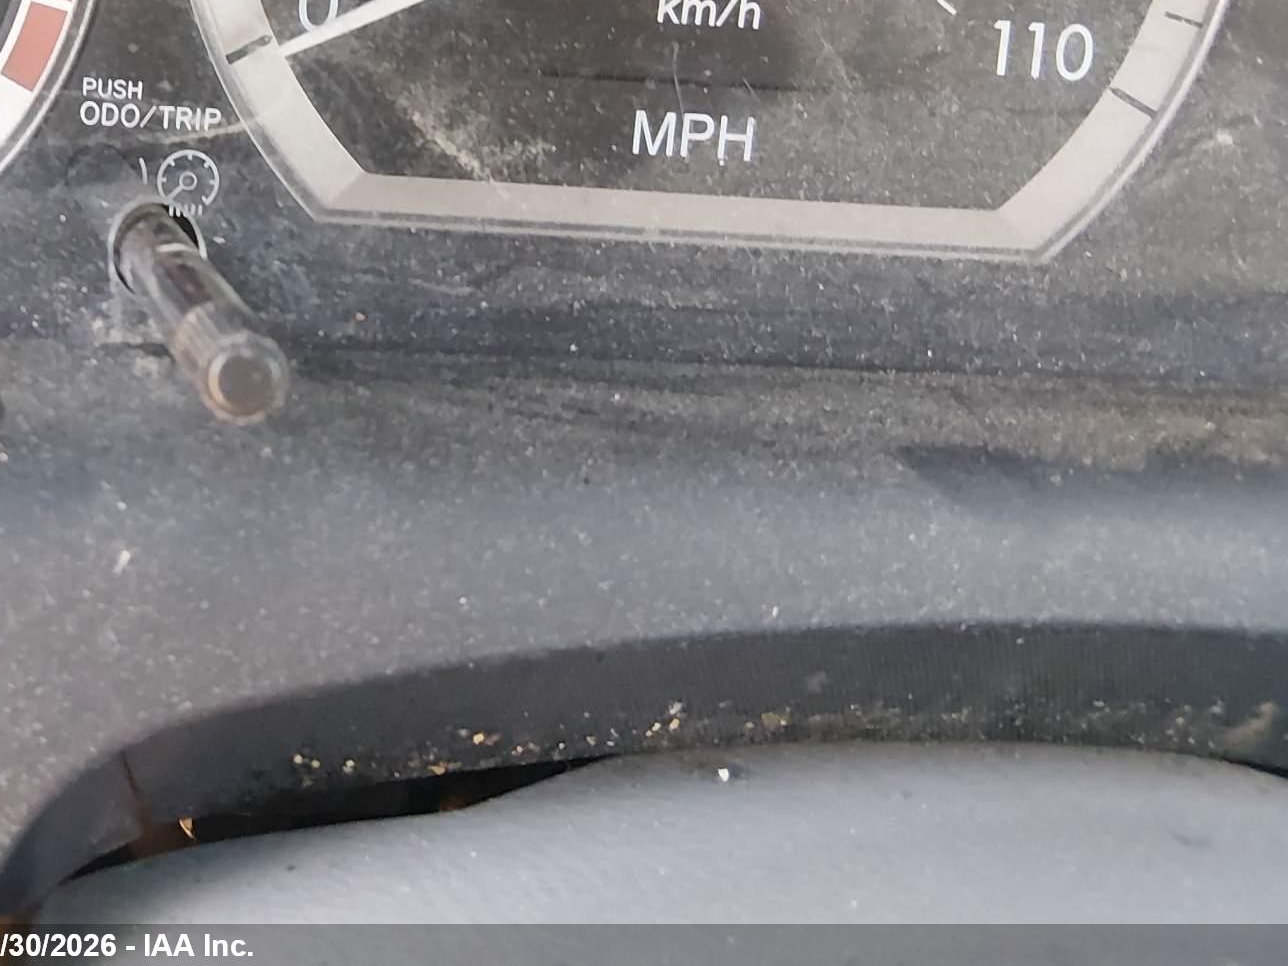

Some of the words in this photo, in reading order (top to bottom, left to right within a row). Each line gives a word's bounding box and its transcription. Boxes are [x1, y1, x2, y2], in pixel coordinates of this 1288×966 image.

[994, 19, 1094, 82] 110
[82, 77, 143, 100] PUSH
[80, 100, 222, 131] ODO/TRIP
[633, 110, 755, 162] MPH
